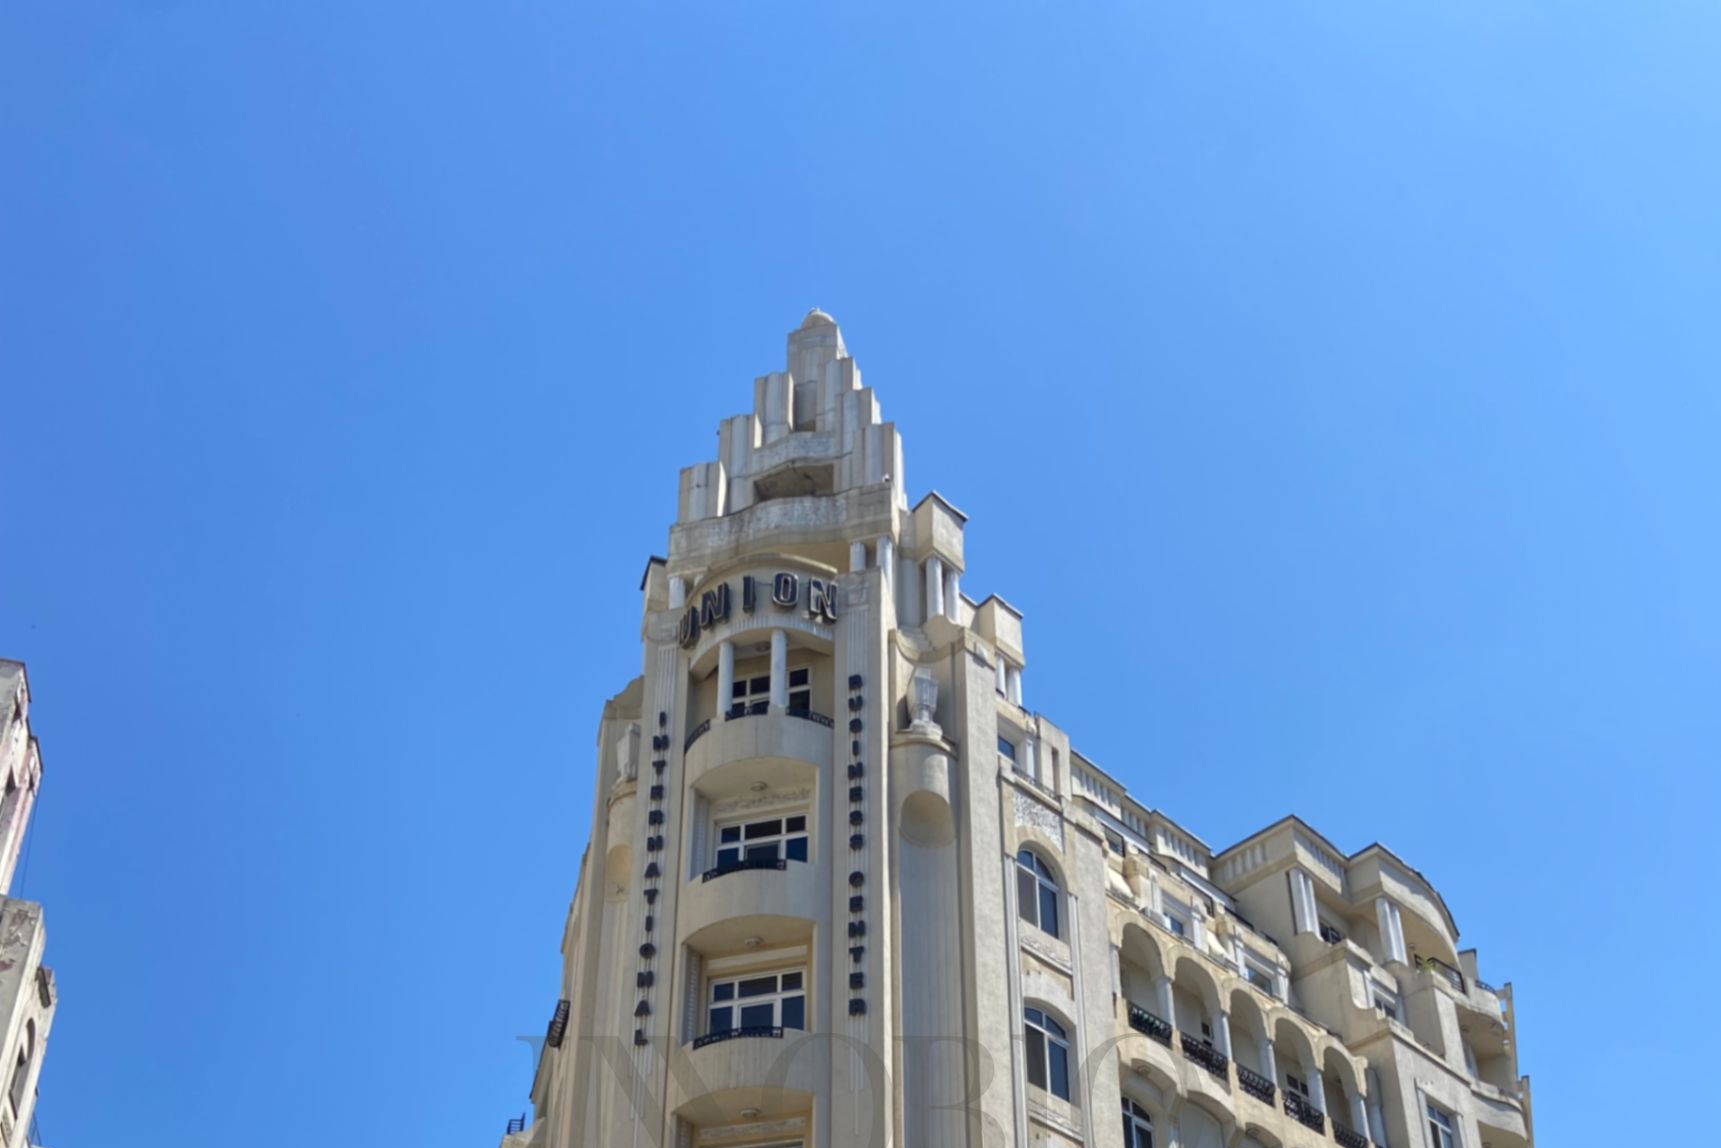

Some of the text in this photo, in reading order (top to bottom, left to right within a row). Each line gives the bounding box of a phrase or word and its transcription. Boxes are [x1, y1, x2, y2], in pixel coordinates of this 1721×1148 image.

[678, 571, 839, 650] UNION
[633, 711, 670, 1046] INTERNATIONAL
[847, 870, 867, 1017] CENTER
